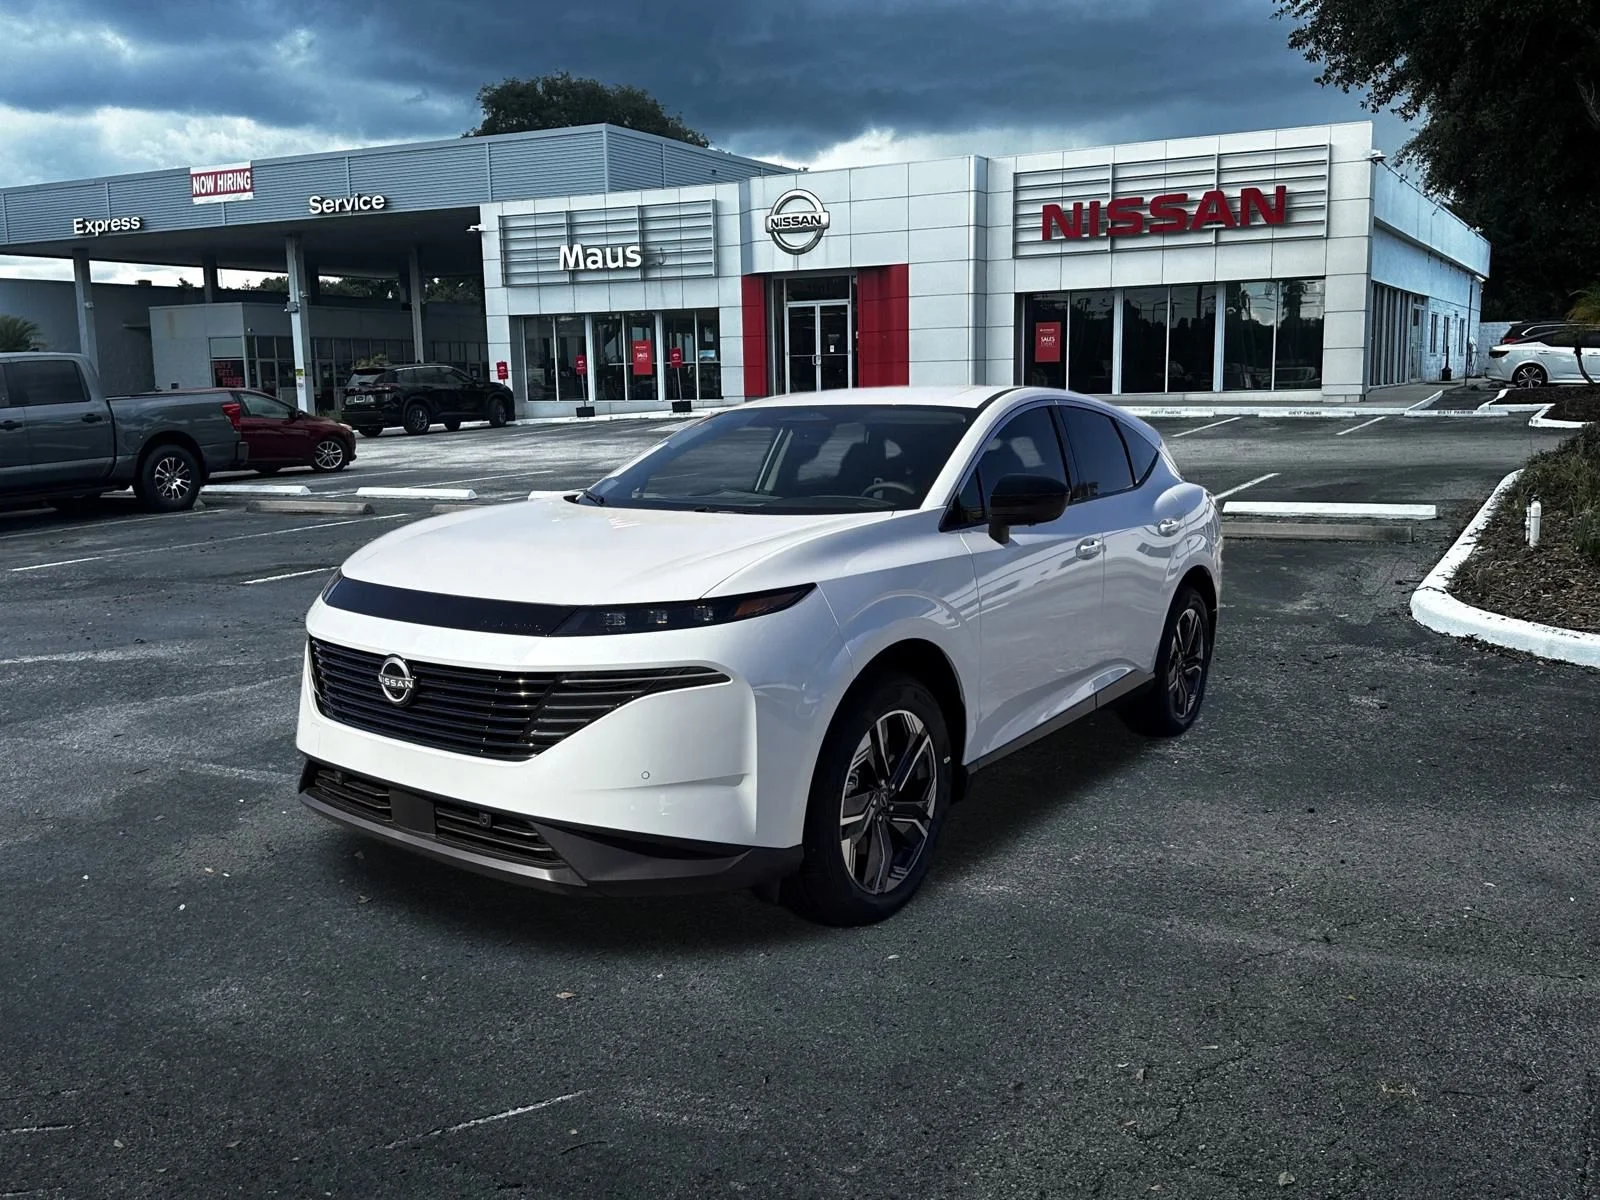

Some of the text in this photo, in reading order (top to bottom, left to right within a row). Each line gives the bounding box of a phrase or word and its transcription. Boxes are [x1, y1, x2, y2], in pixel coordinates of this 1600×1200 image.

[192, 171, 251, 195] NOW HIRING
[308, 193, 386, 215] Service
[1042, 185, 1287, 240] NISSAN
[73, 216, 141, 237] Express
[770, 214, 822, 228] NISSAN
[559, 244, 642, 270] Maus
[378, 675, 413, 688] NISSAN
